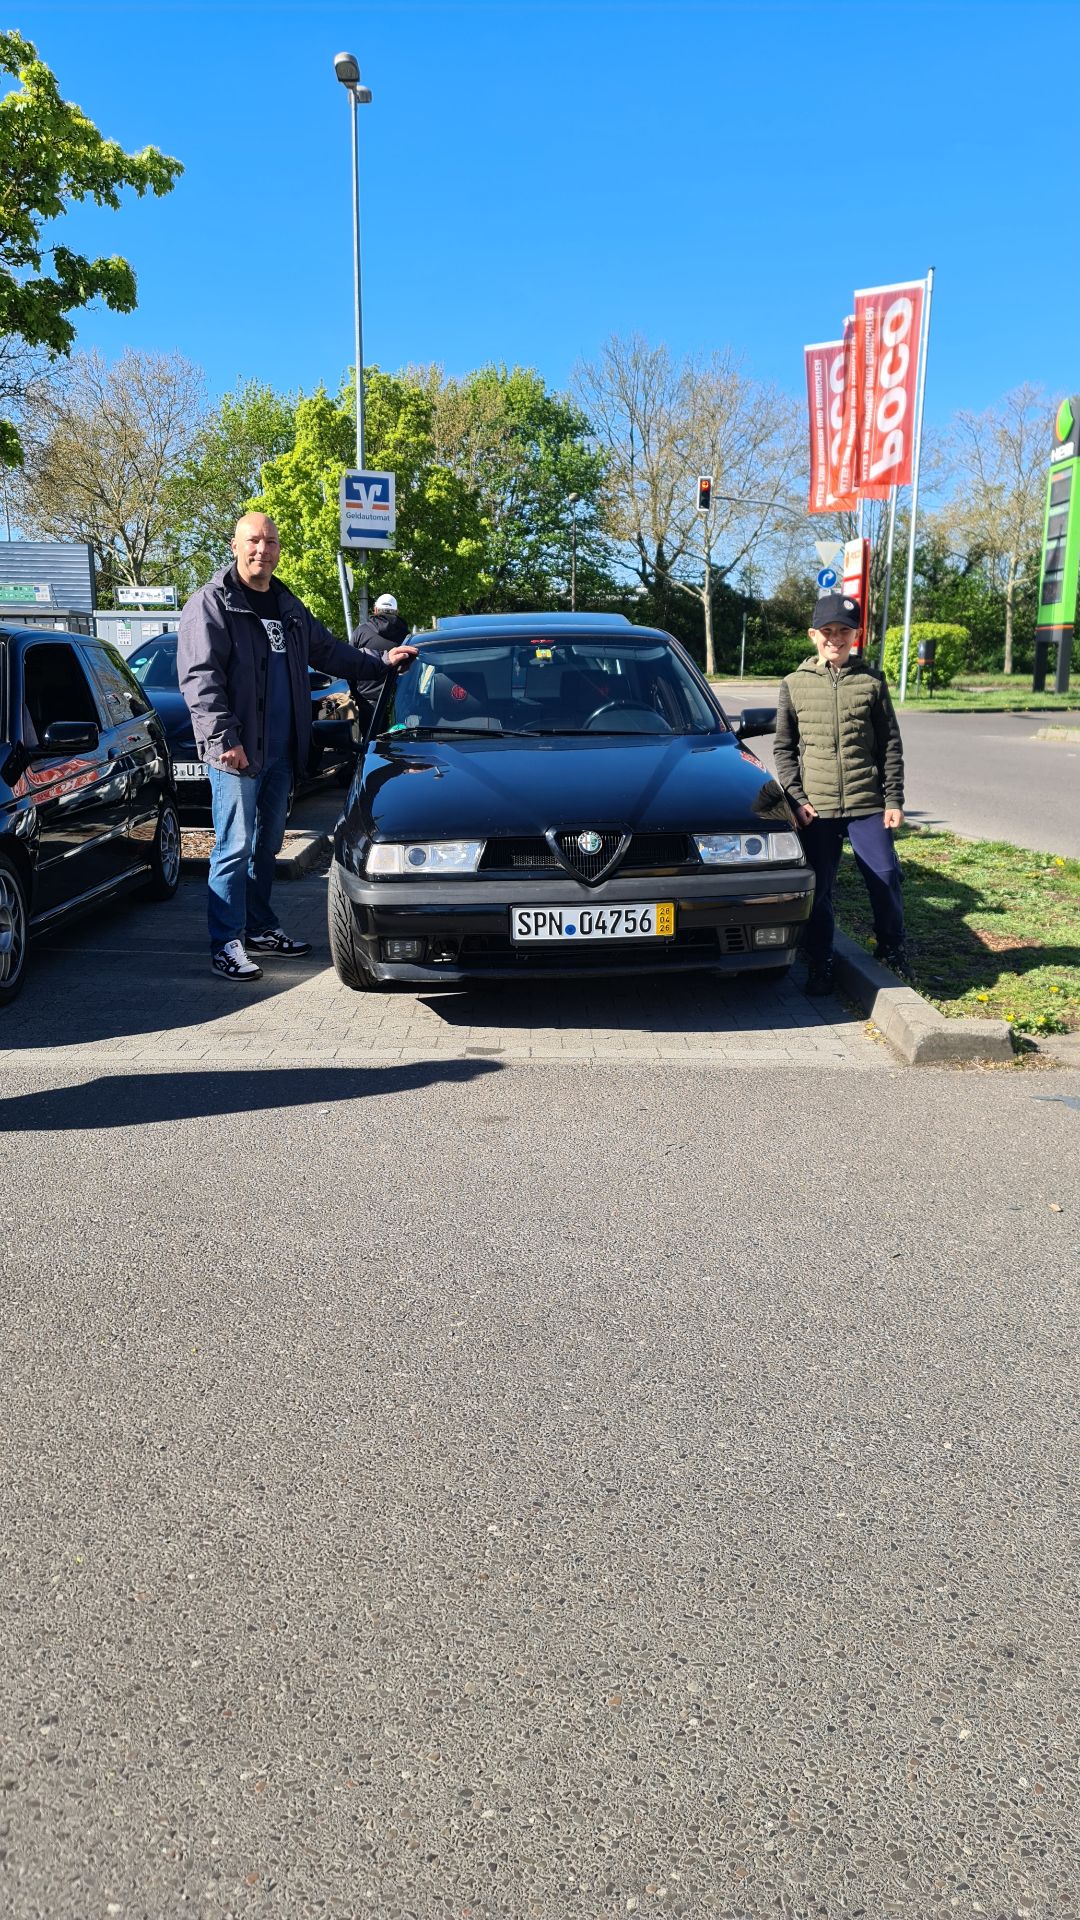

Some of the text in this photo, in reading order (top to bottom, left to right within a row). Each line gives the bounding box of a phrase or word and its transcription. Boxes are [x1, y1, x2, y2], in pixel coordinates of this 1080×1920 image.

[346, 512, 390, 521] Geldautomat
[660, 907, 670, 915] 28
[518, 909, 651, 936] SPN 04756
